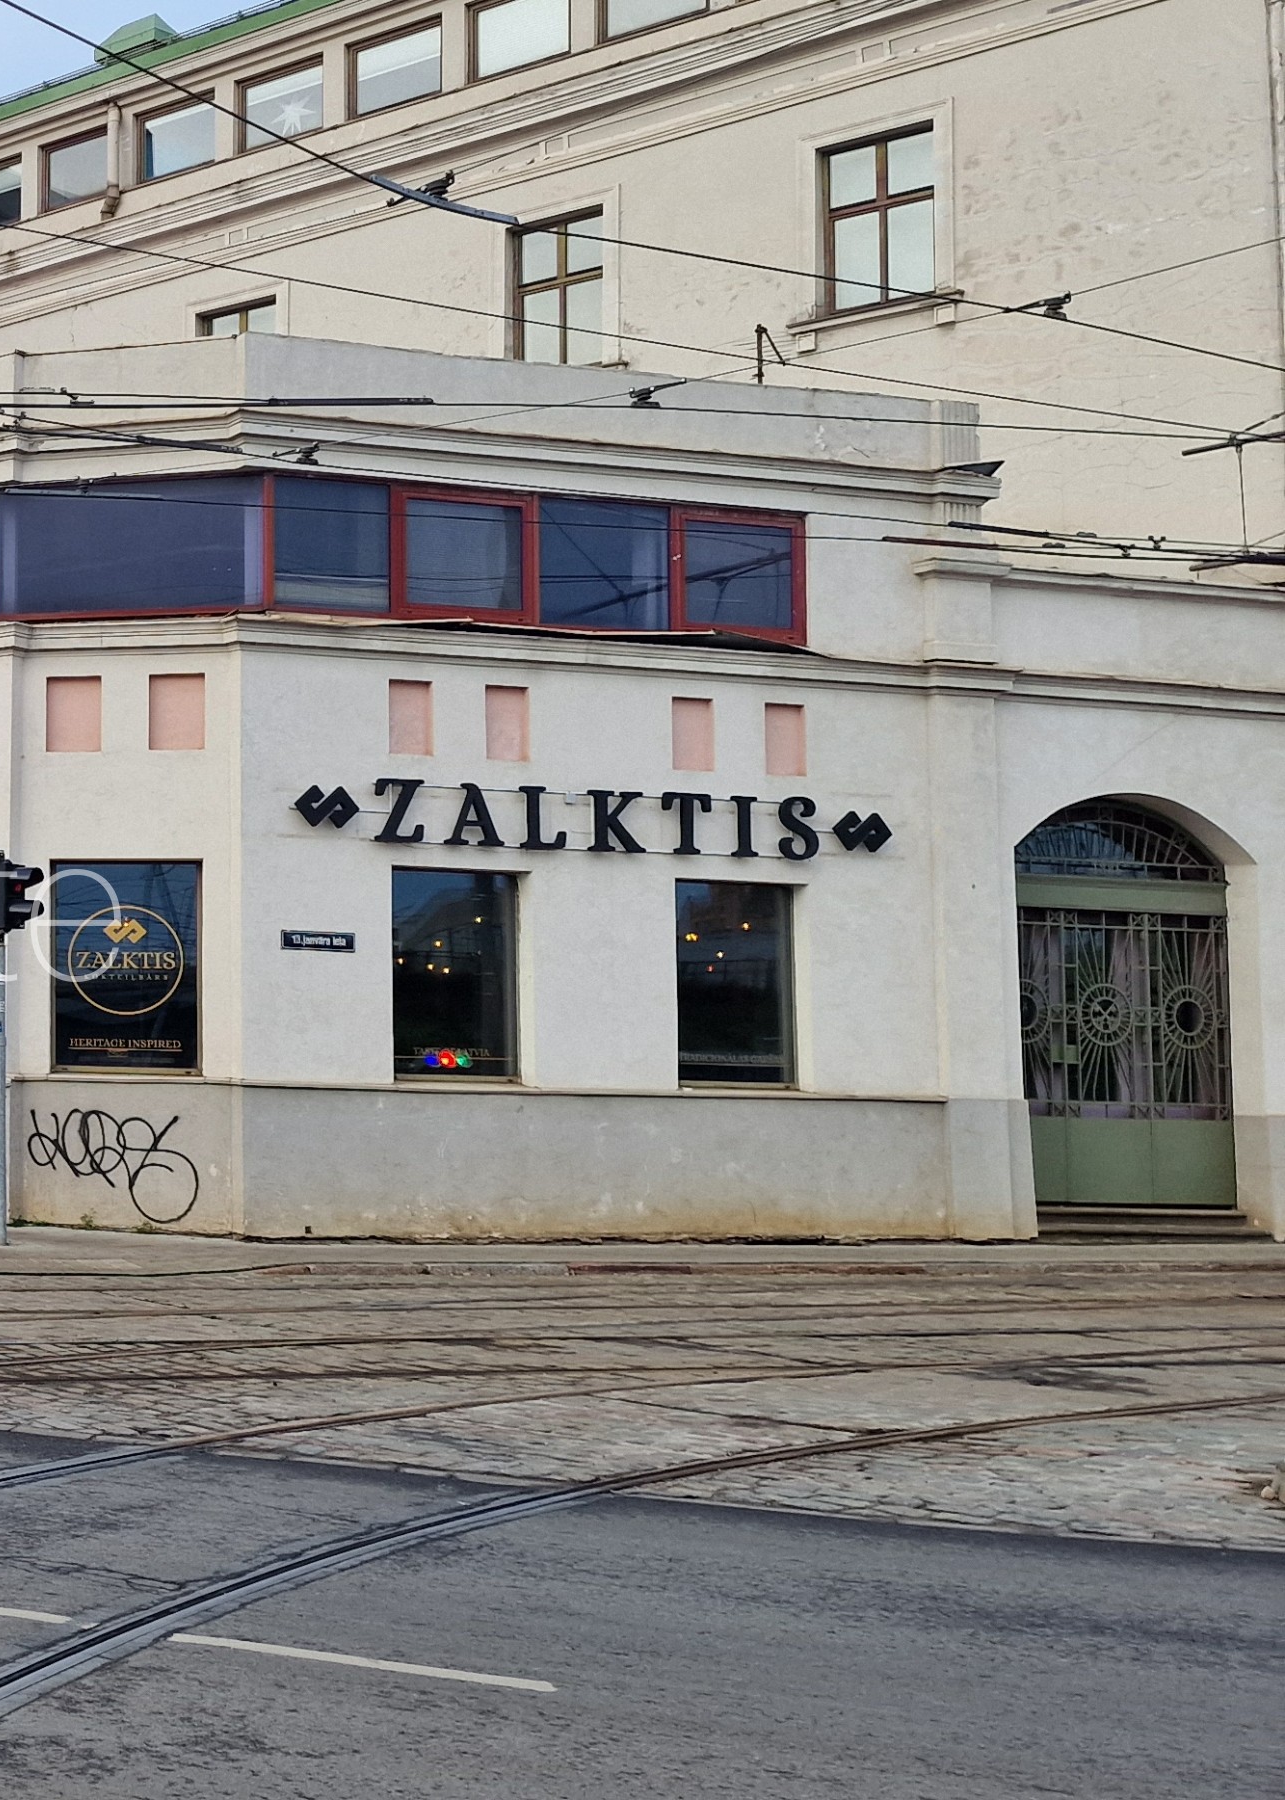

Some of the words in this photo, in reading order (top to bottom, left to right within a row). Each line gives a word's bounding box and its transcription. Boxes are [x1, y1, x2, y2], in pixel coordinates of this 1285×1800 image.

[374, 777, 821, 861] ZALKTIS
[76, 951, 176, 970] ZALKTIS
[70, 1038, 126, 1048] HERITAGE
[128, 1040, 182, 1049] INSPIRED
